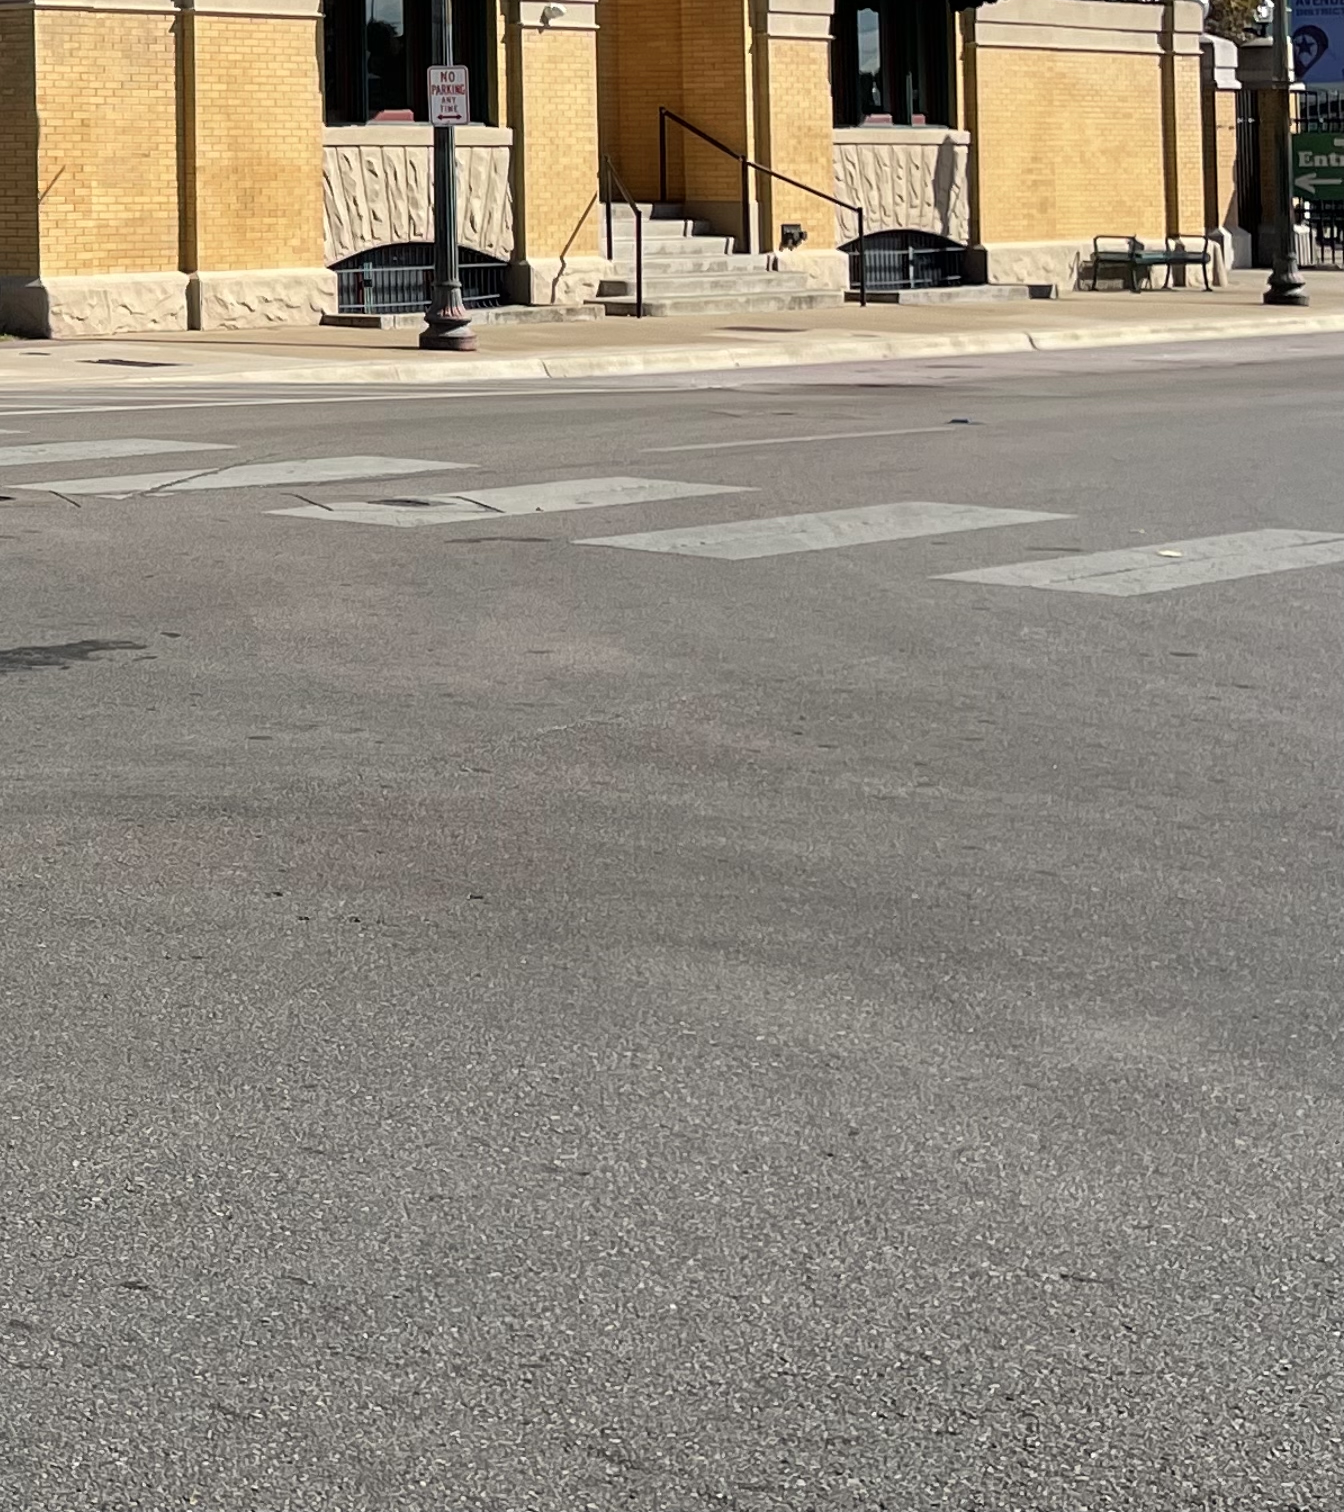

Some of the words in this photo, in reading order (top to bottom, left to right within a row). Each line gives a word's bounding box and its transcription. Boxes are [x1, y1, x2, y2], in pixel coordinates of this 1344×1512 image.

[440, 71, 455, 83] NO
[431, 84, 465, 96] PARKING
[441, 96, 457, 104] ANY
[440, 104, 458, 113] TIME
